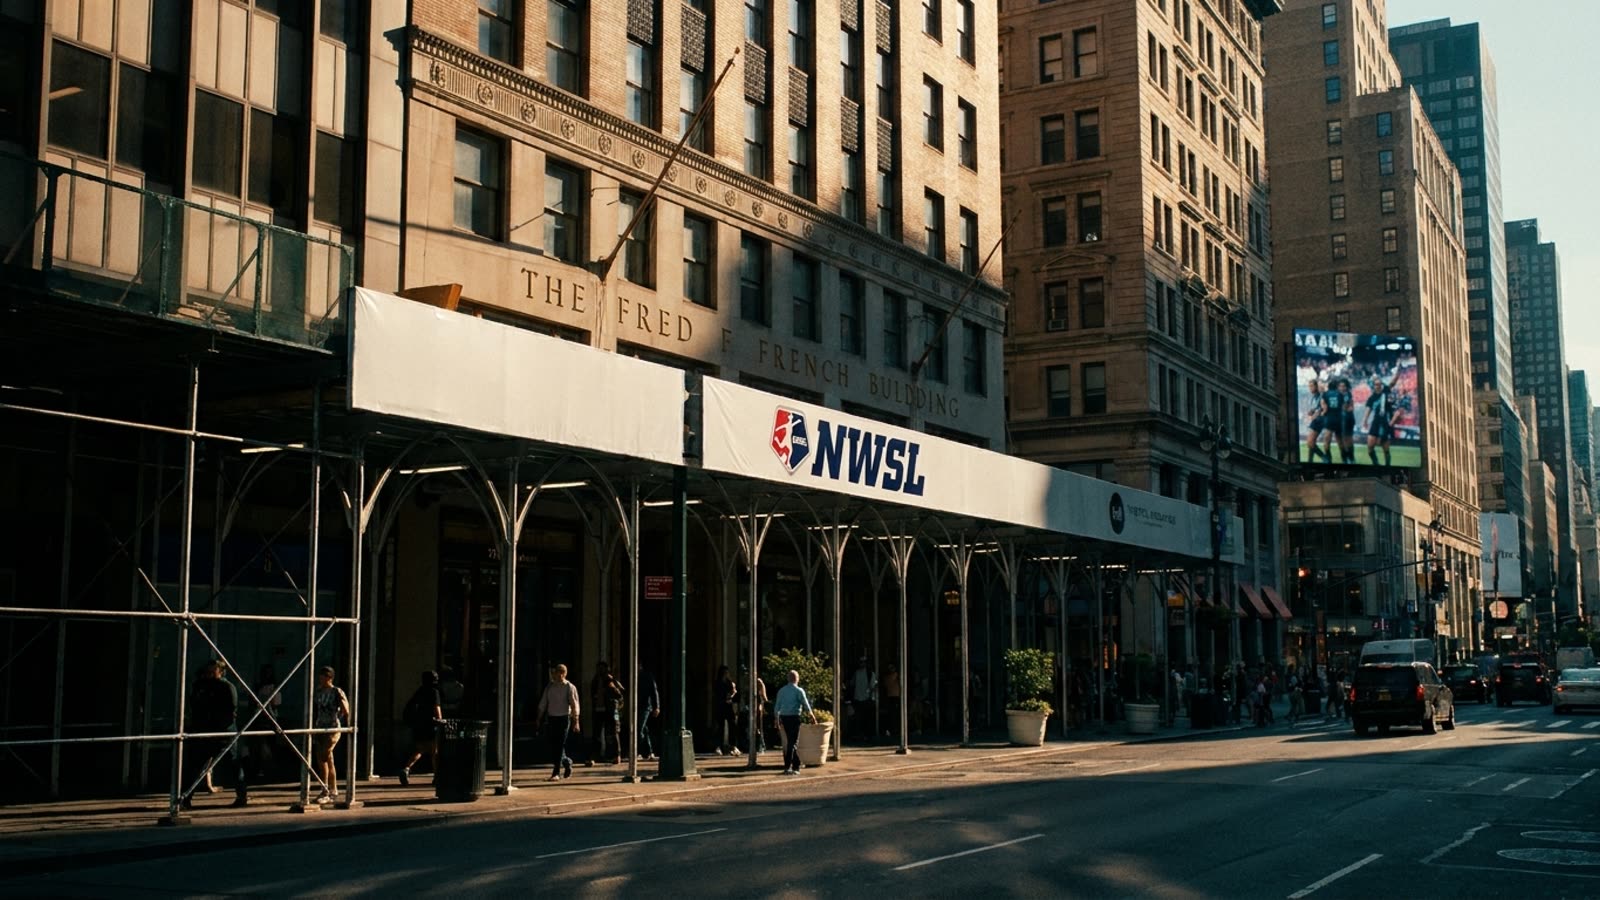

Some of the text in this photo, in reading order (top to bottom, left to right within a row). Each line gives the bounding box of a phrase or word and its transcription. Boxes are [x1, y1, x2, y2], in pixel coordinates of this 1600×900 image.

[520, 267, 586, 314] THE
[617, 295, 693, 342] FRED
[721, 326, 733, 353] F
[759, 338, 849, 388] FRENCH
[811, 421, 925, 496] NWSL
